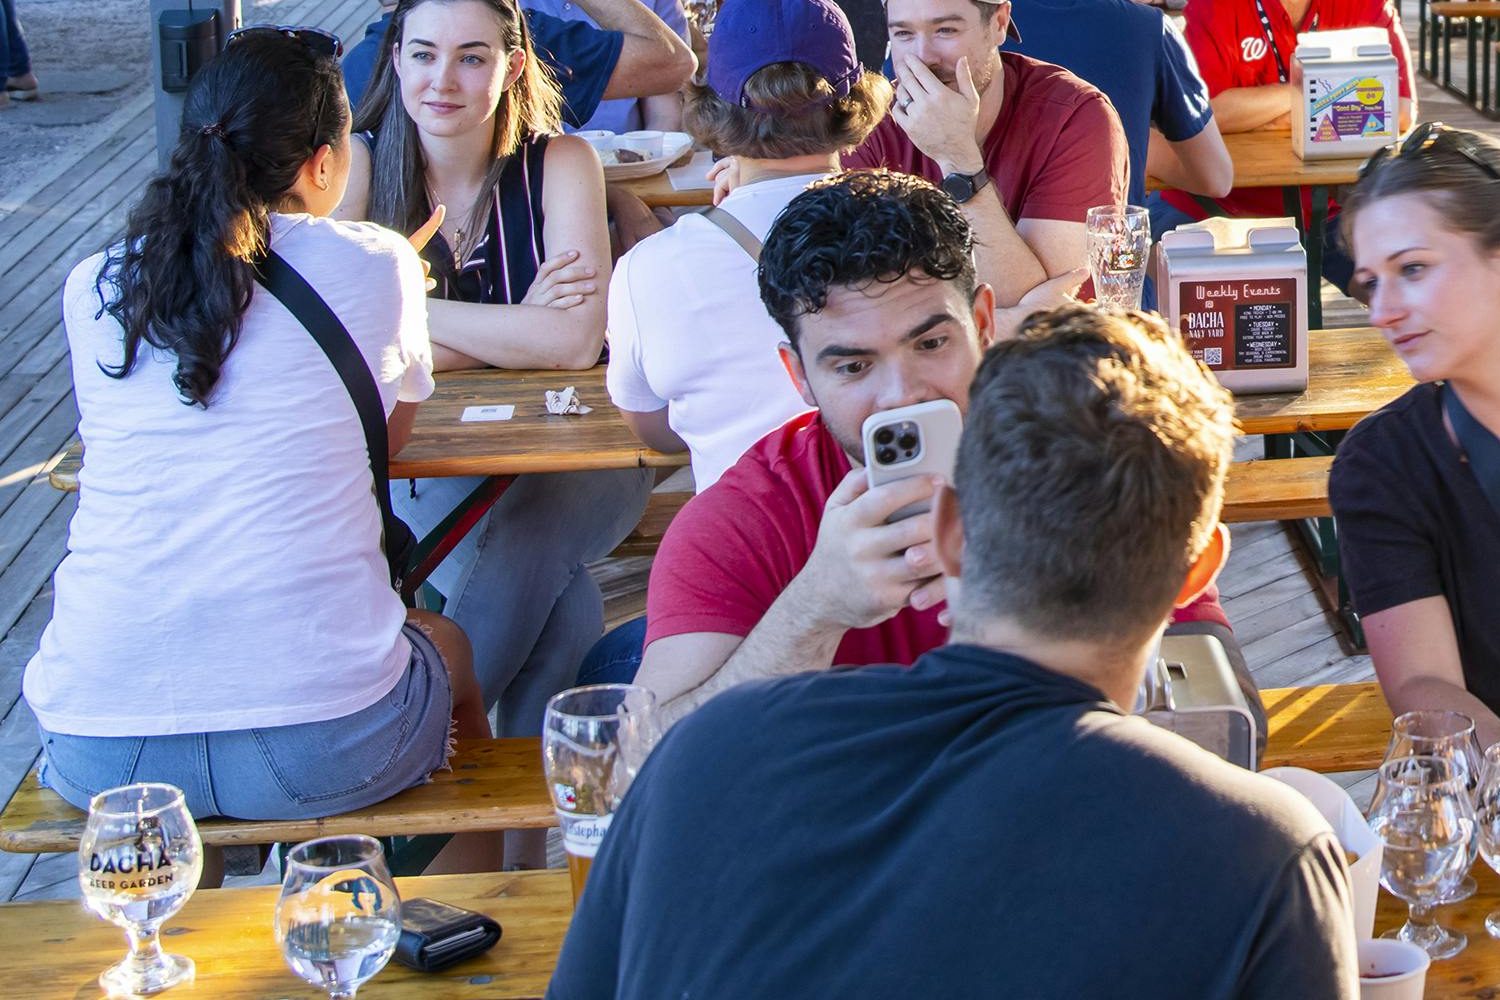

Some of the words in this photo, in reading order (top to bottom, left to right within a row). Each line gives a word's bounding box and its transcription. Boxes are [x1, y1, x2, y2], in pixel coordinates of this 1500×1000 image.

[1241, 37, 1267, 62] W
[1196, 285, 1238, 301] Weekly
[1243, 284, 1281, 298] Events
[1189, 311, 1224, 329] DACHA
[1189, 330, 1207, 339] NAVY
[1208, 328, 1224, 338] YARD
[90, 848, 171, 874] DACHA
[90, 879, 116, 890] BEER
[120, 873, 174, 890] GARDEN
